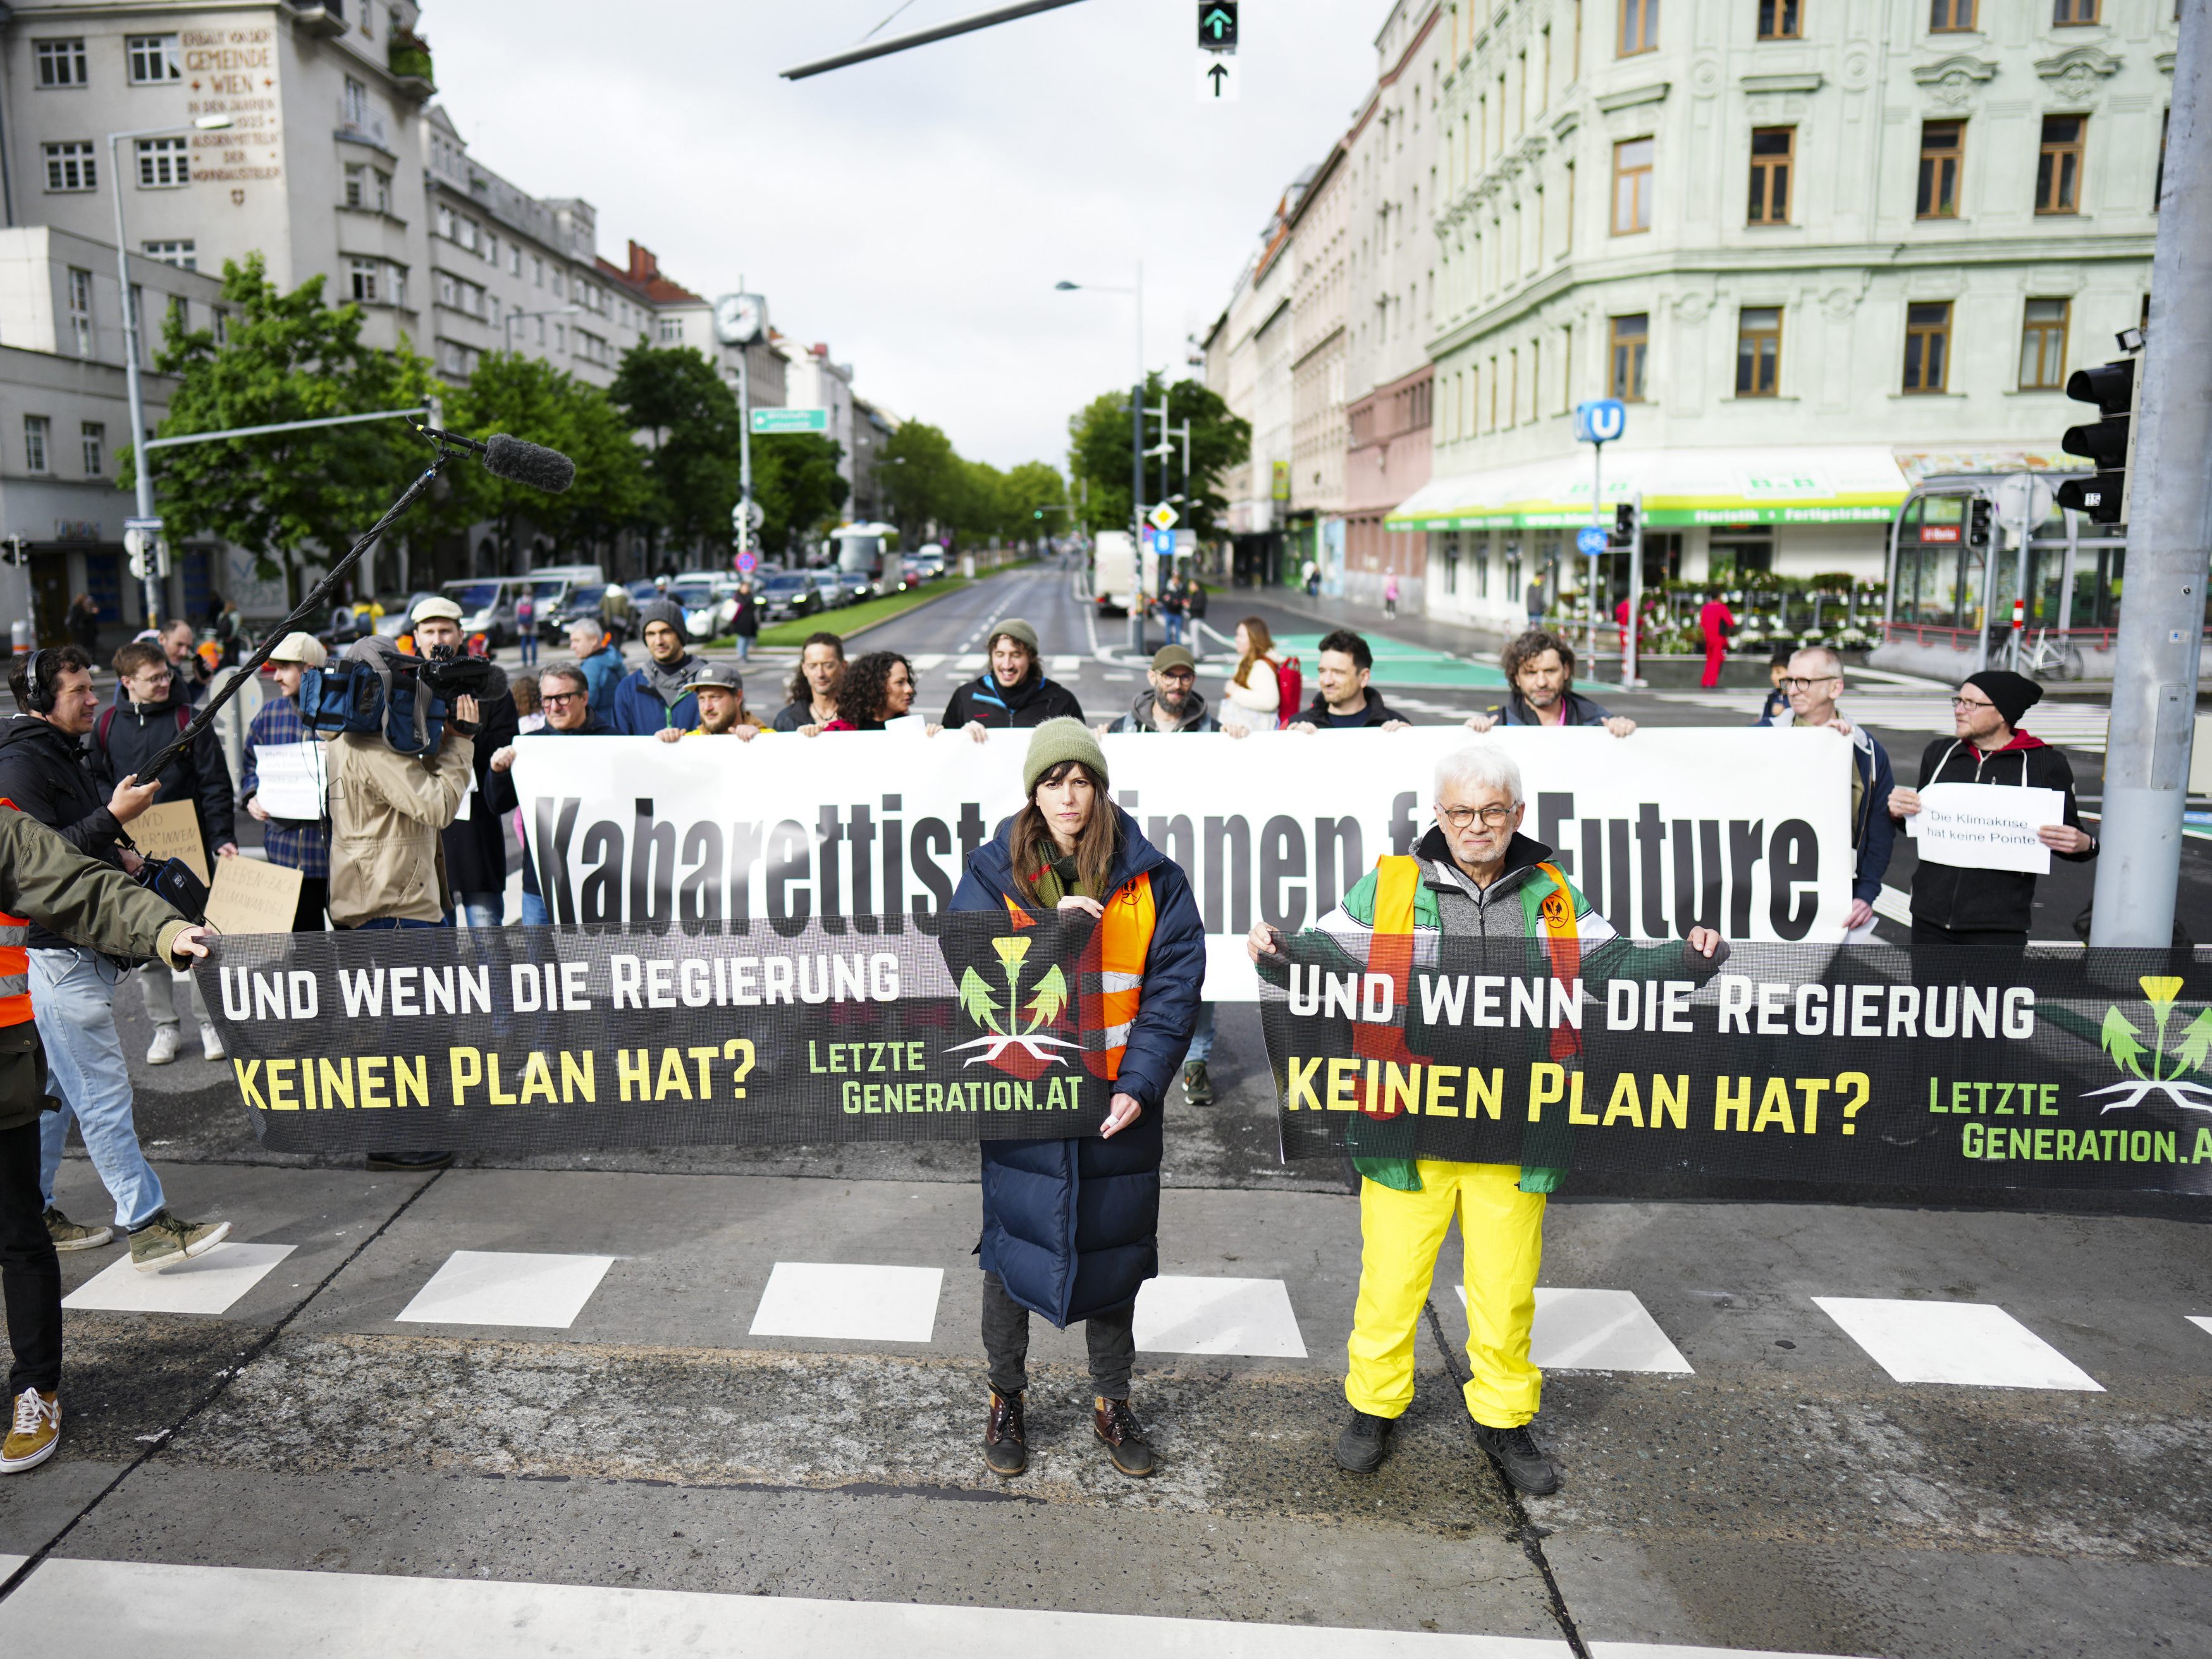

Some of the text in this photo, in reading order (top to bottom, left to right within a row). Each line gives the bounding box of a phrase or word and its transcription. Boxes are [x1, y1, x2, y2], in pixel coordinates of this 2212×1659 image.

[185, 47, 270, 71] GEMEINDE
[209, 74, 254, 94] WIEN
[223, 150, 246, 164] DER
[1593, 408, 1620, 438] U
[1694, 510, 1759, 523] Floristik
[1927, 826, 2036, 845] hat keine Pointe
[1931, 811, 2029, 830] Die Klimakrise
[1537, 792, 1819, 941] Future
[219, 952, 900, 1021] UND WENN DIE REGIERUNG
[1288, 963, 2036, 1040] UND WENN DIE REGIERUNG
[233, 1038, 756, 1111] KEINEN PLAN HAT?
[808, 1039, 926, 1074] LETZTE
[842, 1075, 1084, 1114] GENERATION.AT
[1287, 1056, 1871, 1136] KEINEN PLAN HAT?
[1929, 1077, 2060, 1116] LETZTE
[1962, 1122, 2212, 1165] GENERATION.A
